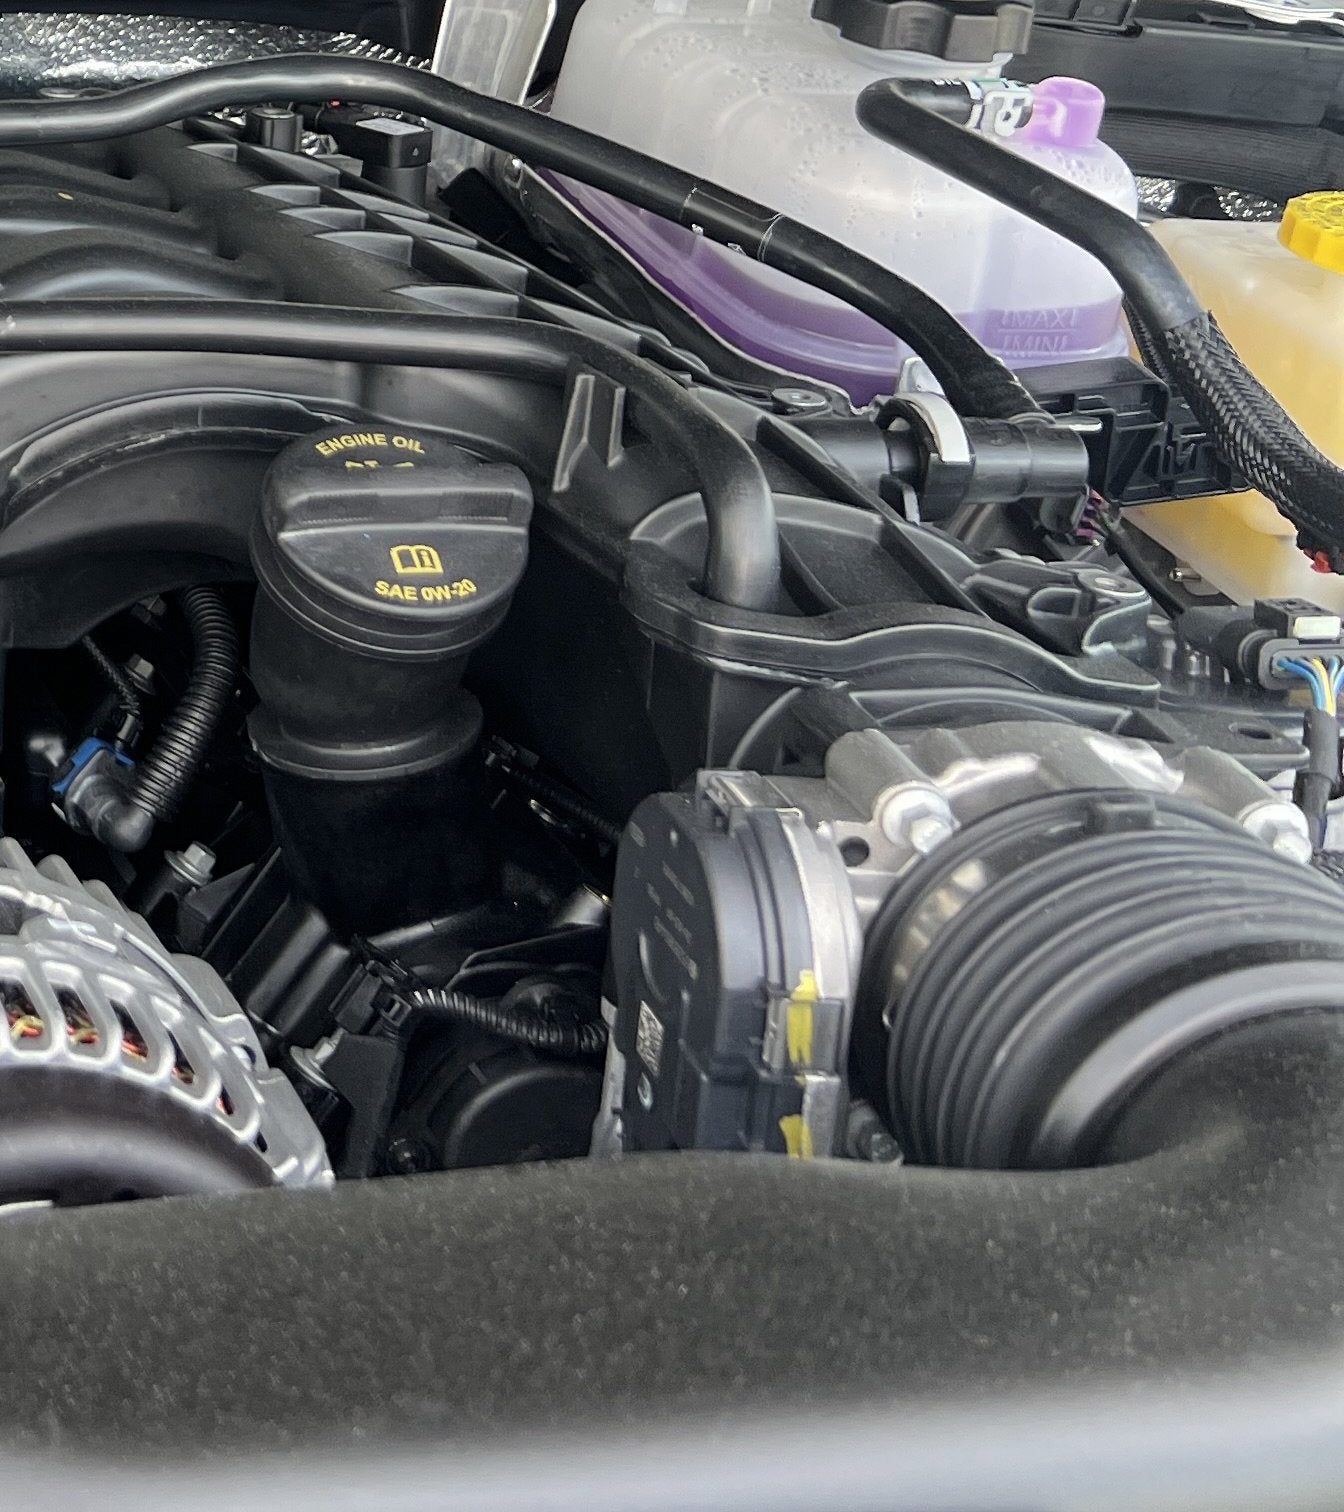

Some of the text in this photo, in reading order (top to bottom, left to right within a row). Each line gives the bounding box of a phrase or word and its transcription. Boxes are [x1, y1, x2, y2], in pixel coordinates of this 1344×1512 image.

[315, 433, 426, 457] ENGINE OIL
[374, 578, 477, 601] SAE 0W-20
